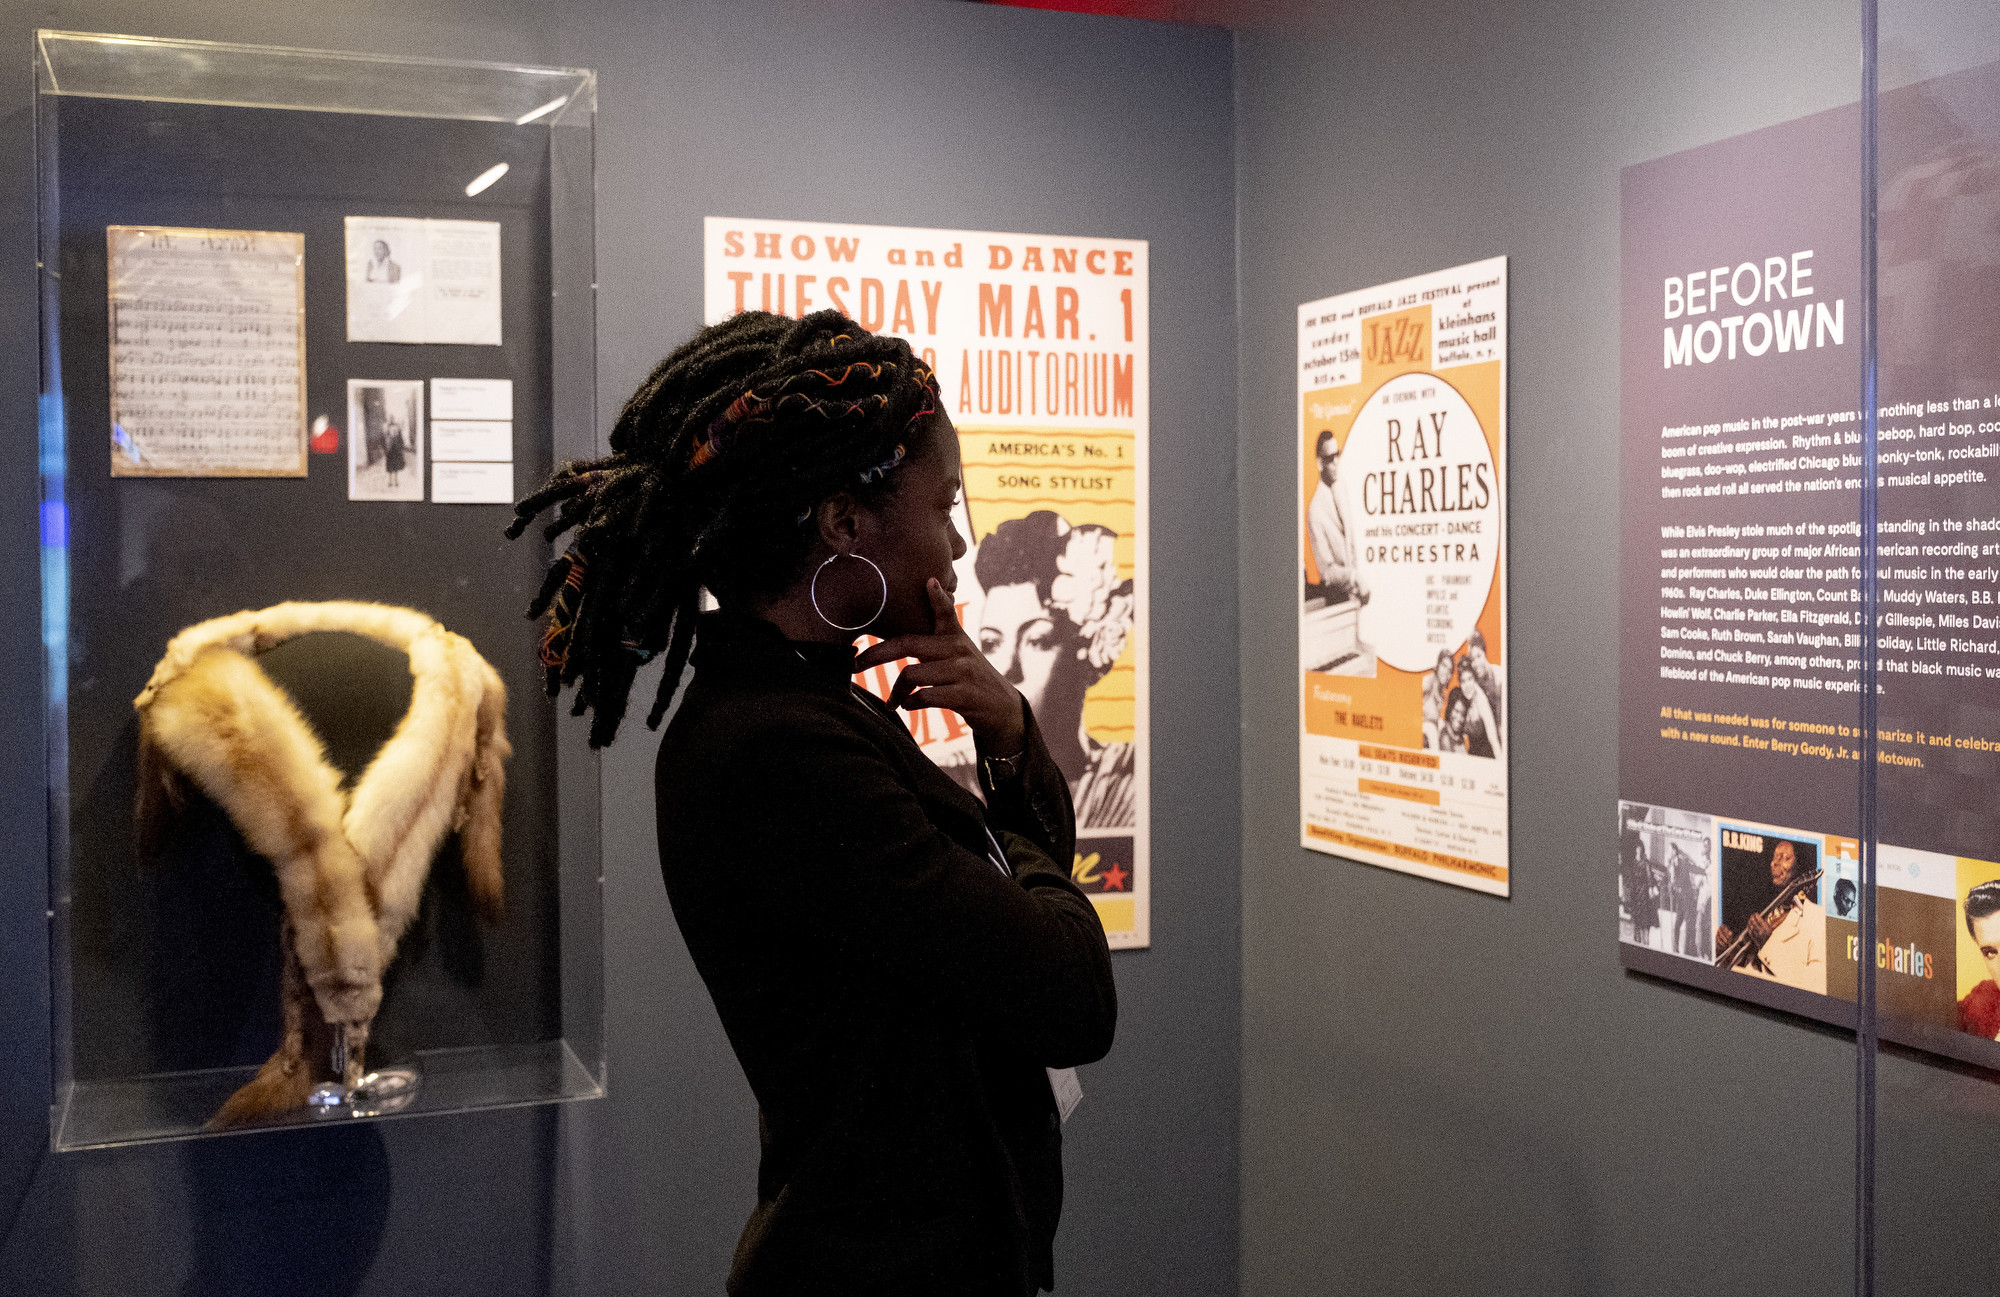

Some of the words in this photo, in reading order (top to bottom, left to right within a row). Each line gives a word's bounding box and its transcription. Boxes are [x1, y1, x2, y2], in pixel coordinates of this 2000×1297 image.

[724, 231, 860, 263] SHOW
[887, 244, 963, 268] and
[989, 245, 1134, 276] DANCE
[1422, 285, 1461, 300] FESTIVAL
[1664, 250, 1813, 319] BEFORE
[727, 271, 942, 337] TUESDAY
[979, 283, 1096, 341] MAR.
[1121, 289, 1133, 342] 1
[1439, 312, 1495, 329] kleinhans
[1368, 317, 1424, 365] JAZZ
[1439, 332, 1469, 348] music
[1474, 326, 1496, 342] hall
[1664, 299, 1844, 369] MOTOWN
[1304, 355, 1336, 370] october
[959, 348, 1134, 418] AUDITORIUM
[1662, 425, 1701, 438] American
[1703, 423, 1721, 437] pop
[1723, 419, 1749, 432] music
[1763, 416, 1778, 429] the
[1781, 414, 1825, 429] post-war
[1827, 410, 1855, 426] years
[1880, 402, 1923, 417] nothing
[1927, 401, 1949, 414] less
[1953, 398, 1979, 411] than
[989, 443, 1075, 456] AMERICA'S
[1084, 445, 1107, 457] No.
[1118, 447, 1122, 457] 1
[1388, 411, 1447, 463] RAY
[1662, 446, 1686, 458] boom
[1698, 442, 1733, 456] creative
[1735, 437, 1787, 454] expression.
[1792, 435, 1831, 450] Rhythm
[1920, 423, 1945, 437] hard
[1949, 423, 1975, 437] bop,
[998, 476, 1040, 488] SONG
[1050, 477, 1112, 489] STYLIST
[1662, 466, 1702, 480] bluegrass,
[1704, 463, 1747, 475] doo-wop,
[1748, 458, 1796, 473] electrified
[1799, 456, 1839, 470] Chicago
[1364, 463, 1489, 515] CHARLES
[1662, 487, 1680, 498] then
[1682, 485, 1701, 497] rock
[1704, 484, 1720, 496] and
[1722, 482, 1736, 495] roll
[1739, 482, 1749, 494] all
[1751, 480, 1782, 493] served
[1785, 479, 1800, 492] the
[1804, 478, 1842, 491] nation's
[1888, 472, 1930, 487] musical
[1934, 469, 1986, 487] appetite.
[1366, 527, 1378, 536] and
[1382, 527, 1392, 535] his
[1396, 523, 1438, 536] CONCERT
[1448, 521, 1480, 534] DANCE
[1661, 526, 1684, 538] While
[1687, 526, 1706, 538] Elvis
[1708, 525, 1740, 539] Presley
[1742, 524, 1764, 536] stole
[1767, 523, 1792, 536] much
[1809, 522, 1825, 535] the
[1877, 519, 1925, 535] standing
[1943, 518, 1962, 531] the
[1366, 544, 1479, 562] ORCHESTRA
[1661, 548, 1677, 558] was
[1692, 546, 1750, 560] extraordinary
[1752, 548, 1779, 560] group
[1794, 545, 1822, 560] major
[1824, 544, 1861, 557] African
[1922, 543, 1978, 559] recording
[1661, 567, 1677, 579] and
[1679, 567, 1726, 581] performers
[1728, 568, 1747, 579] who
[1750, 567, 1777, 579] would
[1780, 567, 1803, 579] clear
[1806, 567, 1823, 579] the
[1826, 567, 1848, 581] path
[1894, 566, 1927, 580] music
[1945, 567, 1964, 579] the
[1968, 567, 1999, 583] early
[1661, 587, 1685, 599] 1960s.
[1690, 586, 1705, 601] Ray
[1707, 587, 1742, 601] Charles,
[1745, 587, 1768, 600] Duke
[1771, 588, 1814, 603] Ellington,
[1817, 589, 1847, 601] Count
[1884, 589, 1922, 606] Muddy
[1925, 590, 1968, 605] Waters,
[1972, 591, 1993, 604] B.B.
[1661, 607, 1690, 619] Howlin'
[1691, 607, 1712, 620] Wolf,
[1714, 608, 1745, 621] Charlie
[1748, 609, 1778, 623] Parker,
[1781, 610, 1798, 623] Ella
[1800, 610, 1851, 626] Fitzgerald,
[1886, 613, 1935, 629] Gillespie,
[1939, 614, 1969, 627] Miles
[1661, 626, 1679, 639] Sam
[1680, 627, 1710, 642] Cooke,
[1712, 628, 1732, 642] Ruth
[1734, 629, 1765, 643] Brown,
[1768, 631, 1794, 644] Sarah
[1797, 632, 1841, 648] Vaughan,
[1917, 637, 1946, 651] Little
[1951, 638, 2000, 655] Richard,
[1661, 646, 1695, 661] Domino,
[1697, 649, 1712, 661] and
[1714, 649, 1742, 663] Chuck
[1745, 651, 1772, 667] Berry,
[1774, 656, 1807, 669] among
[1809, 655, 1844, 669] others,
[1886, 659, 1908, 673] that
[1912, 660, 1942, 675] black
[1947, 663, 1981, 677] music
[1661, 666, 1697, 681] lifeblood
[1710, 670, 1724, 682] the
[1726, 671, 1770, 686] American
[1772, 676, 1790, 690] pop
[1793, 677, 1822, 690] music
[1661, 706, 1672, 718] All
[1674, 707, 1692, 720] that
[1694, 712, 1712, 722] was
[1714, 713, 1748, 726] needed
[1751, 717, 1770, 729] was
[1772, 717, 1787, 730] for
[1789, 720, 1835, 735] someone
[1929, 734, 1951, 747] and
[1661, 727, 1680, 739] with
[1690, 732, 1709, 743] new
[1710, 734, 1741, 746] sound.
[1743, 735, 1769, 750] Enter
[1772, 738, 1798, 756] Berry
[1801, 742, 1834, 760] Gordy,
[1837, 746, 1849, 759] Jr.
[1847, 935, 1858, 961] ra
[1877, 938, 1932, 979] charles
